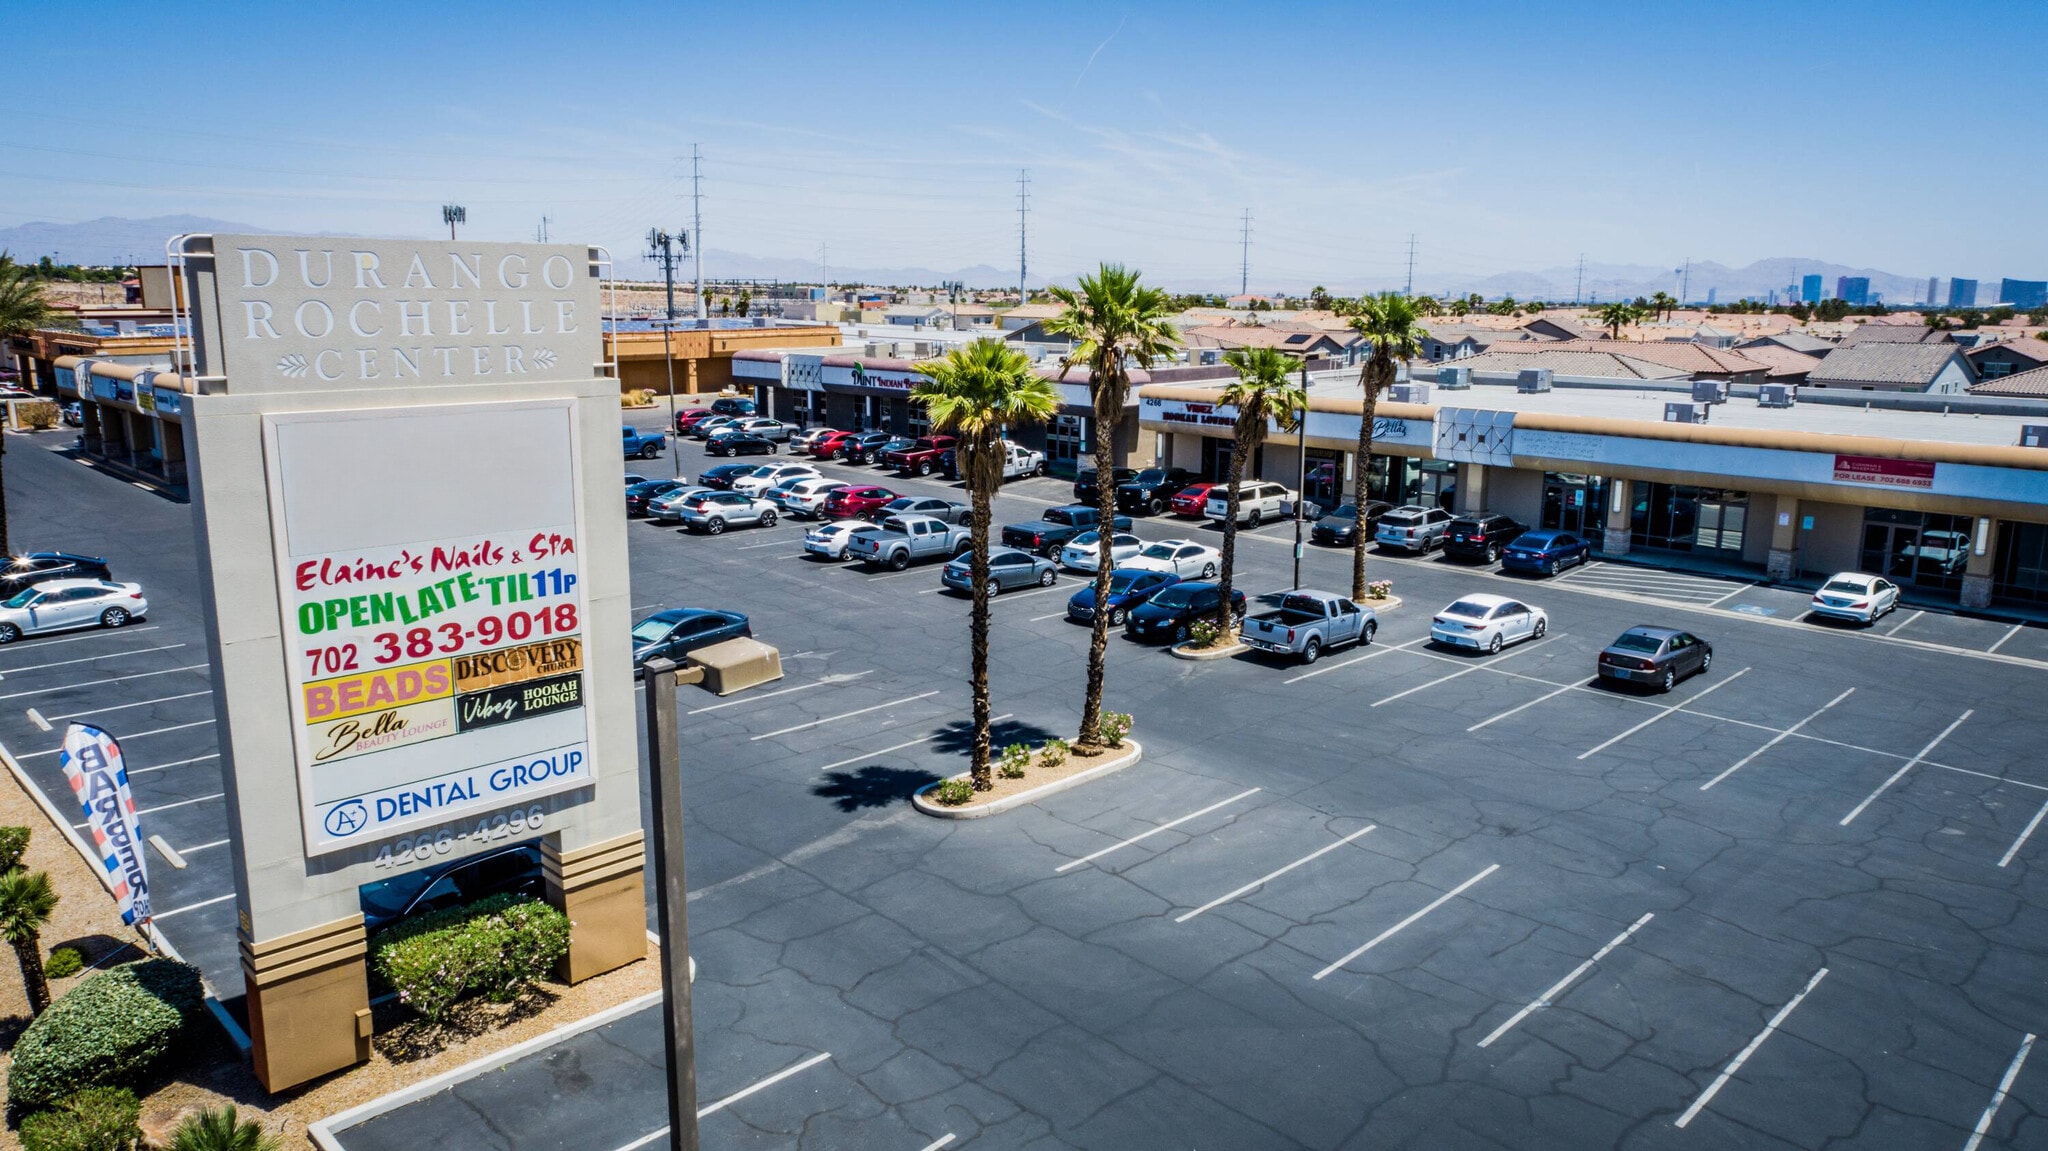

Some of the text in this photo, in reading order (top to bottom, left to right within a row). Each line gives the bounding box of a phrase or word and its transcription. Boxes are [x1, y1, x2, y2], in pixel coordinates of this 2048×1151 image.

[237, 247, 575, 290] DURANGO
[239, 299, 579, 339] ROCHELLE
[315, 344, 529, 381] CENTER
[1851, 474, 1876, 482] LEASE
[296, 549, 424, 591] Elaine's
[430, 540, 504, 573] Nails
[512, 550, 523, 563] &
[298, 592, 395, 635] OPEN
[396, 571, 480, 625] LATE
[306, 603, 578, 676] 702 383-9018
[537, 660, 577, 674] CHURCH
[306, 664, 450, 718] BEADS
[464, 693, 518, 723] Vibez
[523, 680, 577, 700] HOOKAH
[524, 691, 578, 711] LOUNGE
[315, 710, 409, 760] Bella
[356, 718, 448, 752] BEAUTY LOUNGE
[377, 777, 480, 822] DENTAL
[489, 751, 583, 792] GROUP
